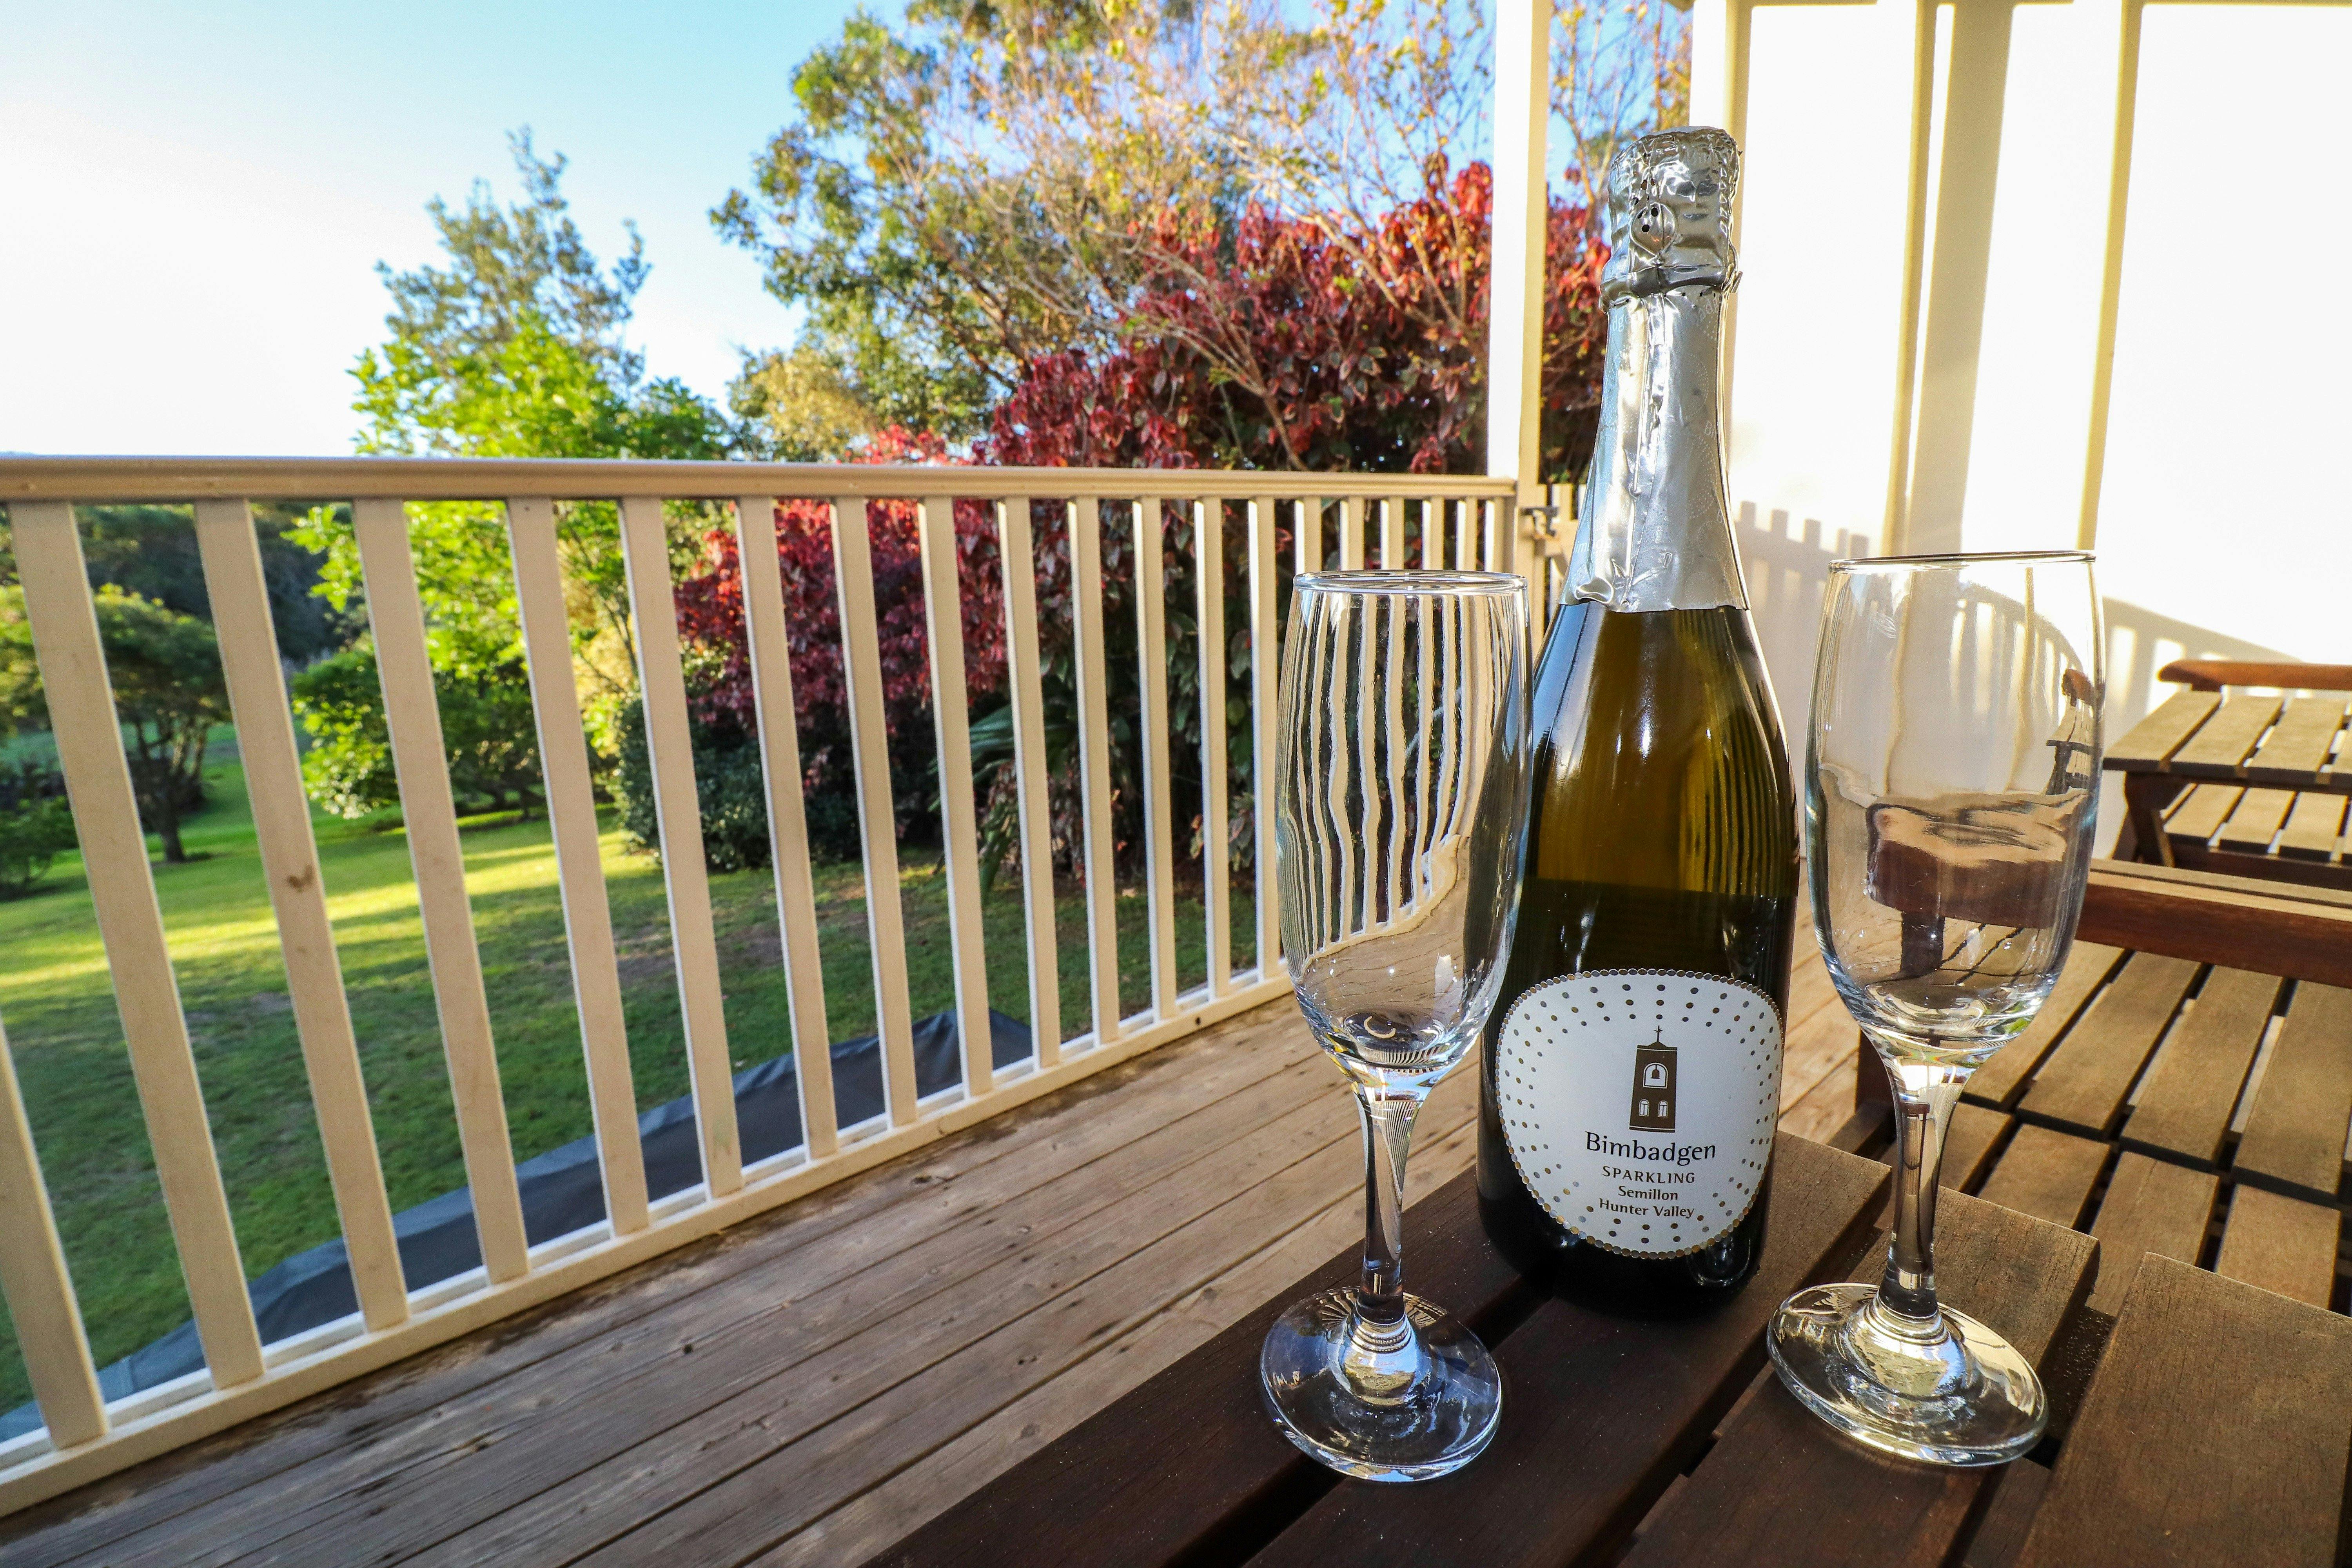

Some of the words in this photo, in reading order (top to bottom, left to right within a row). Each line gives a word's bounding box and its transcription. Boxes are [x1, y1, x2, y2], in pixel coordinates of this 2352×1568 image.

[1586, 1131, 1715, 1166] Bimbadgen
[1602, 1166, 1695, 1183] SPARKLING
[1618, 1185, 1678, 1200] Semillon
[1599, 1198, 1649, 1216] Hunter
[1653, 1206, 1695, 1219] Valley
